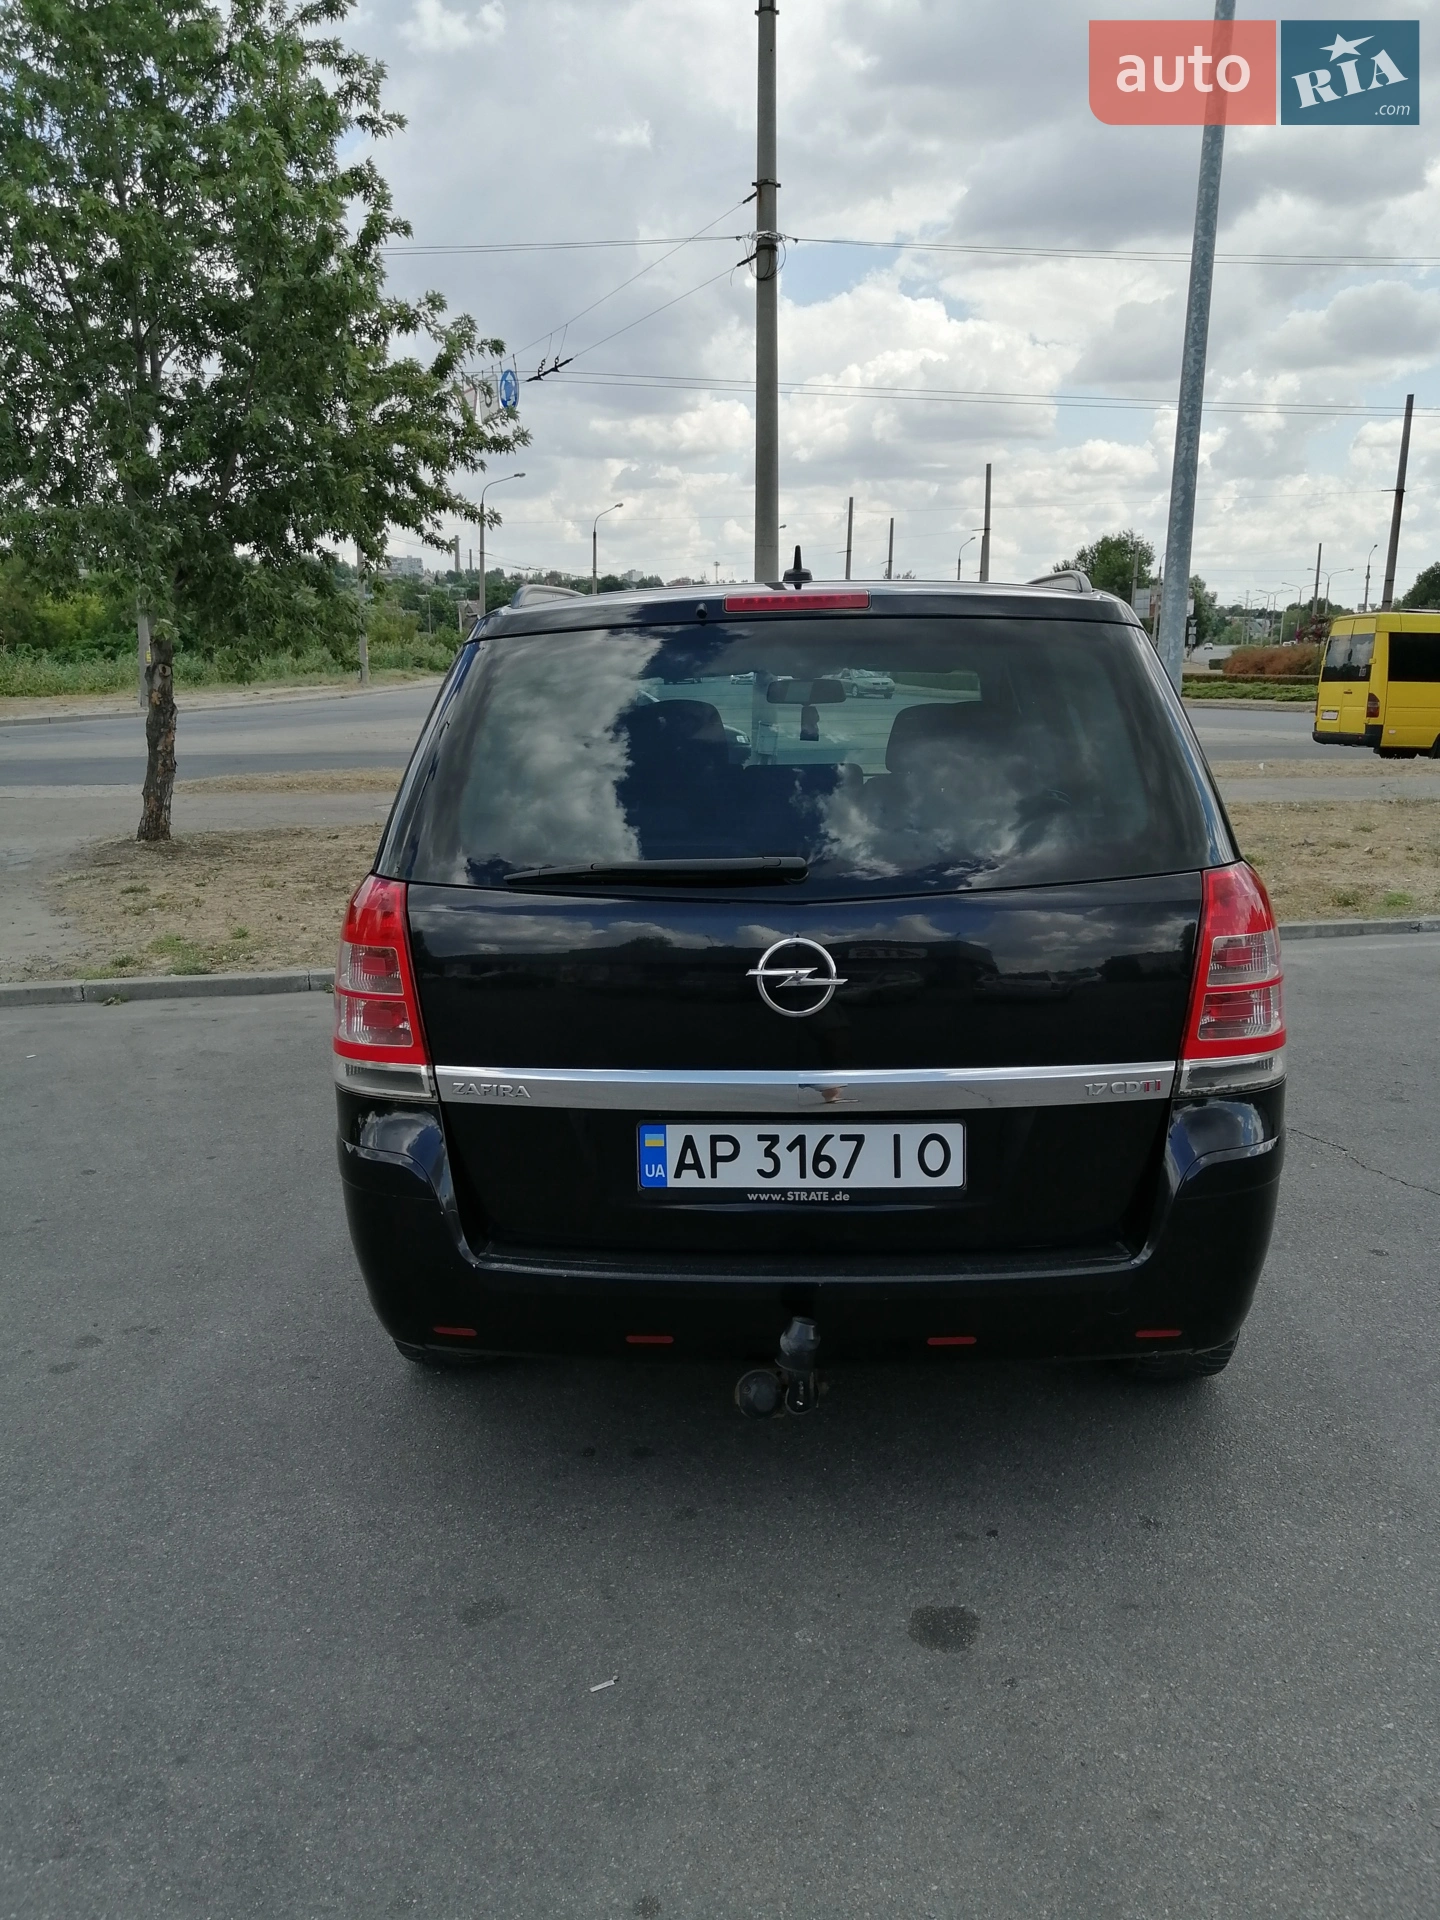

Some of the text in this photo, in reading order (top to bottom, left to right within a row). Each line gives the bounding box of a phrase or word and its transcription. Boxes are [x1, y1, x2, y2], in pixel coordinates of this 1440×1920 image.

[452, 1082, 531, 1098] ZAFIRA
[673, 1134, 741, 1179] AP
[756, 1134, 865, 1179] 3167
[645, 1164, 665, 1178] UA
